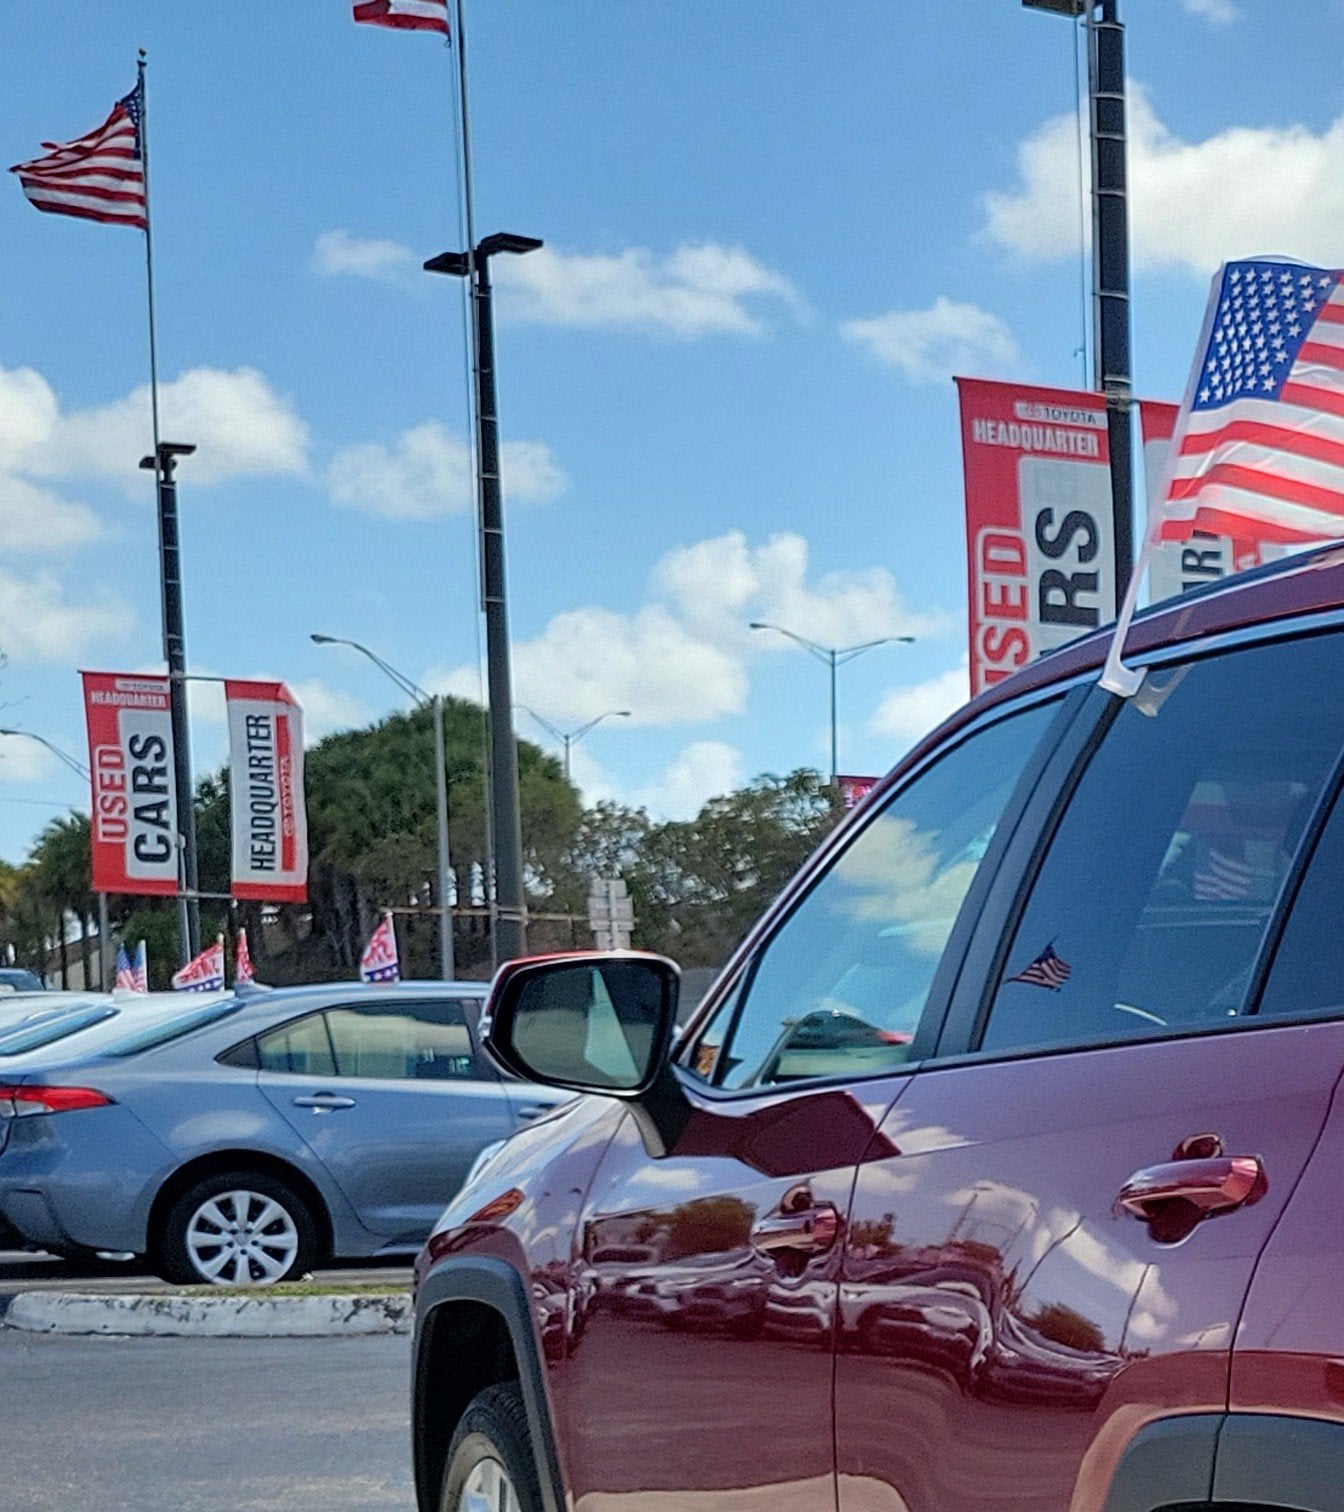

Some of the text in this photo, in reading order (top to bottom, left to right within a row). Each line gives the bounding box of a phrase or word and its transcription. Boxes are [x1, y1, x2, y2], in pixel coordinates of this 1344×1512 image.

[973, 417, 1099, 457] HEADQUARTER
[1044, 406, 1097, 425] TOYOTA
[1035, 507, 1100, 630] RS
[91, 690, 167, 708] HEADQUARTER
[99, 748, 129, 840] USED
[129, 734, 172, 864] CARS
[246, 714, 277, 872] HEADQUARTER
